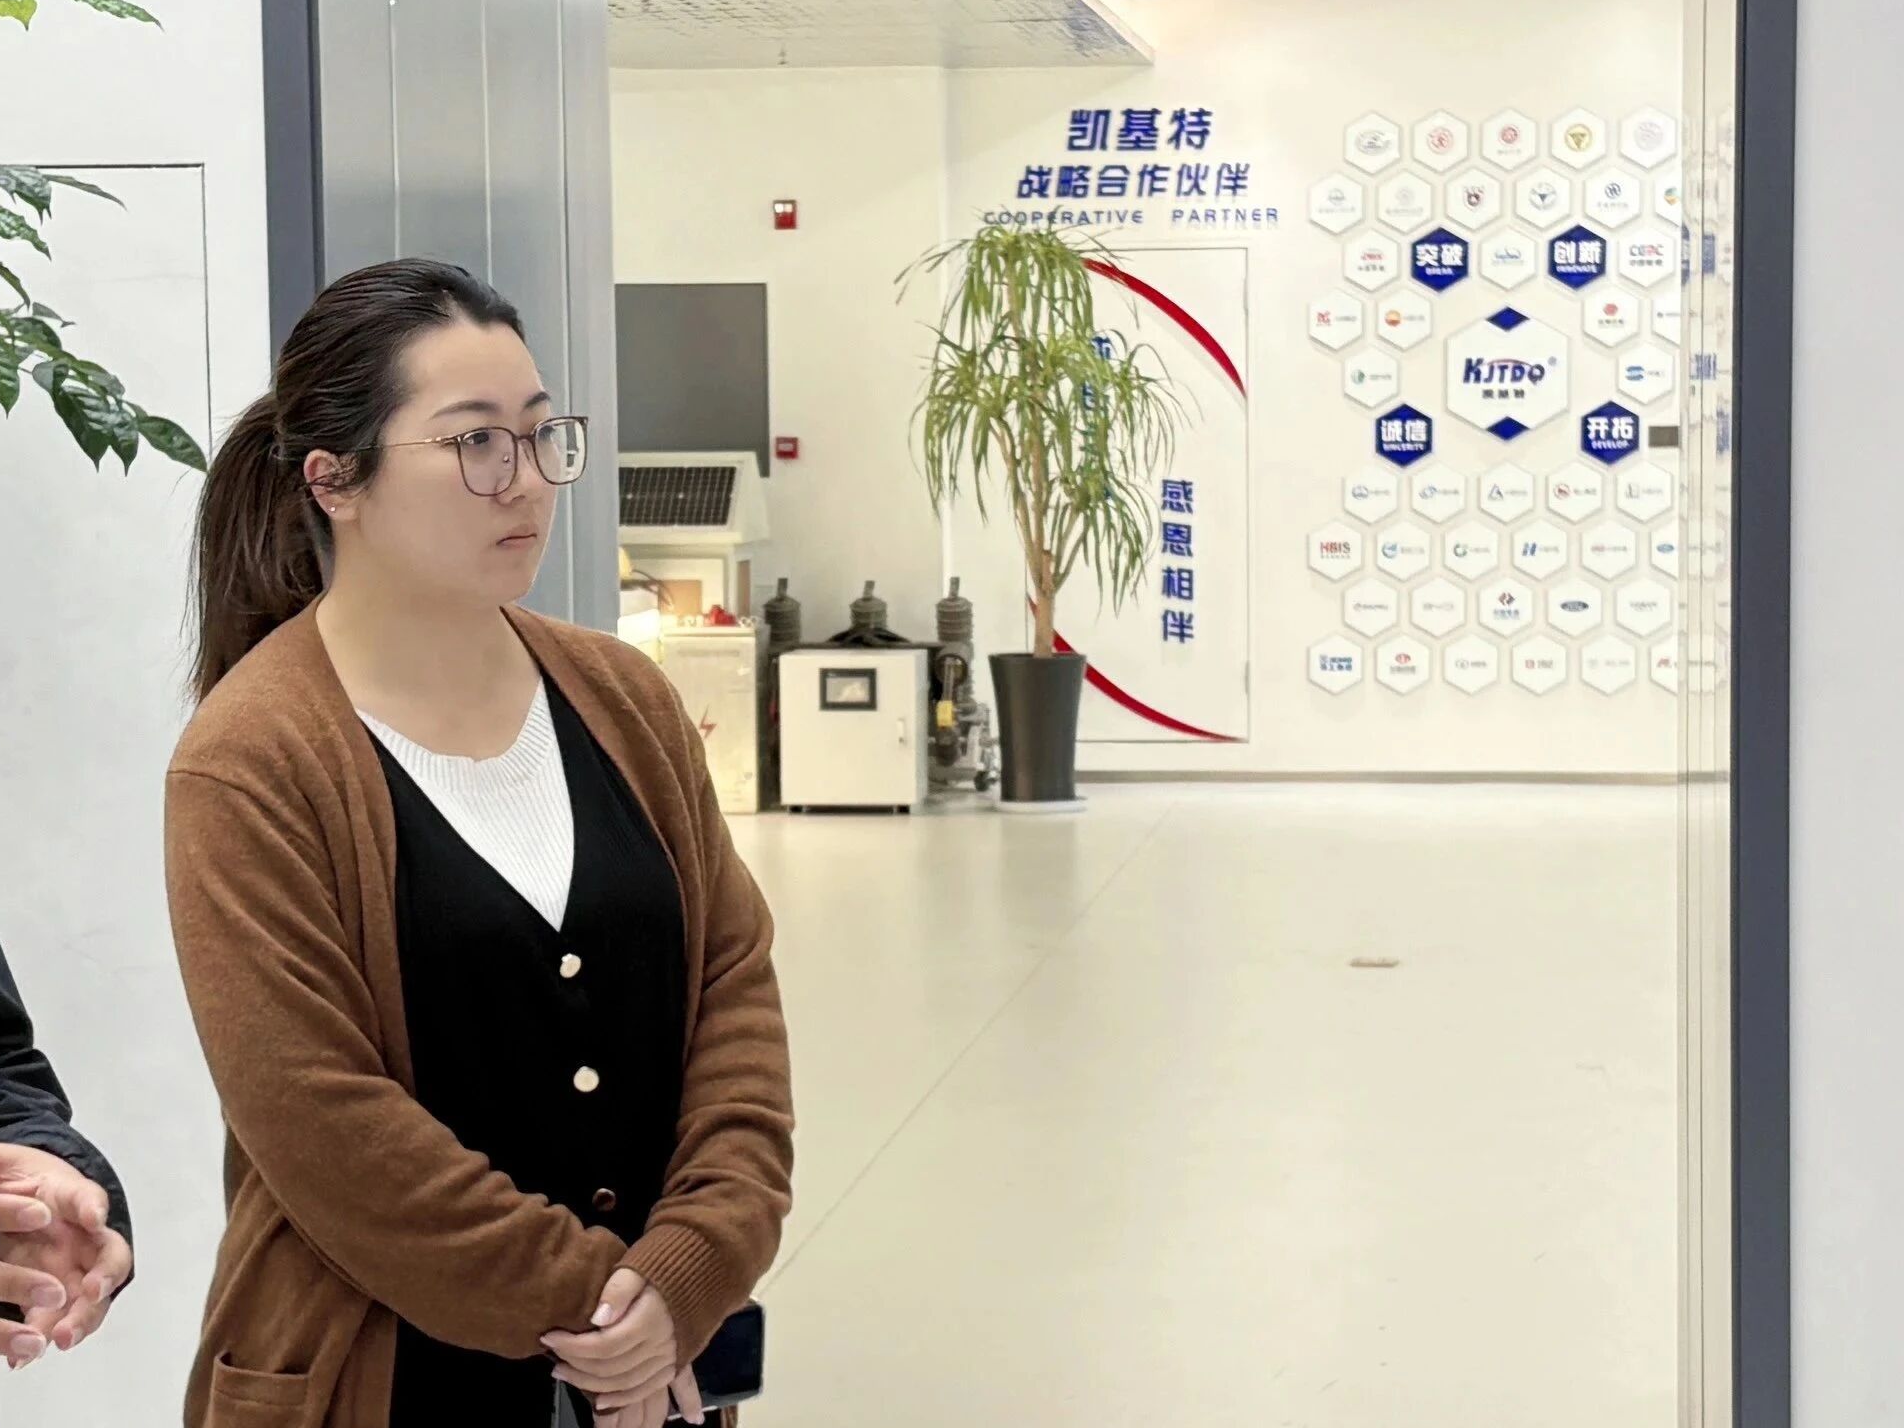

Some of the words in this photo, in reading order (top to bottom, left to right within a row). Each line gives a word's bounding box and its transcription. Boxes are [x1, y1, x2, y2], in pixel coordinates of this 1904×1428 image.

[1066, 107, 1213, 152] 凯基特
[1016, 162, 1250, 199] 战略合作伙伴
[984, 209, 1144, 225] COOPERATIVE
[1171, 207, 1279, 223] PARTNER
[1415, 242, 1465, 268] 突破
[1553, 240, 1603, 264] 创新
[1380, 419, 1429, 443] 诚信
[1586, 416, 1635, 440] 开拓
[1160, 477, 1194, 645] 感恩相伴
